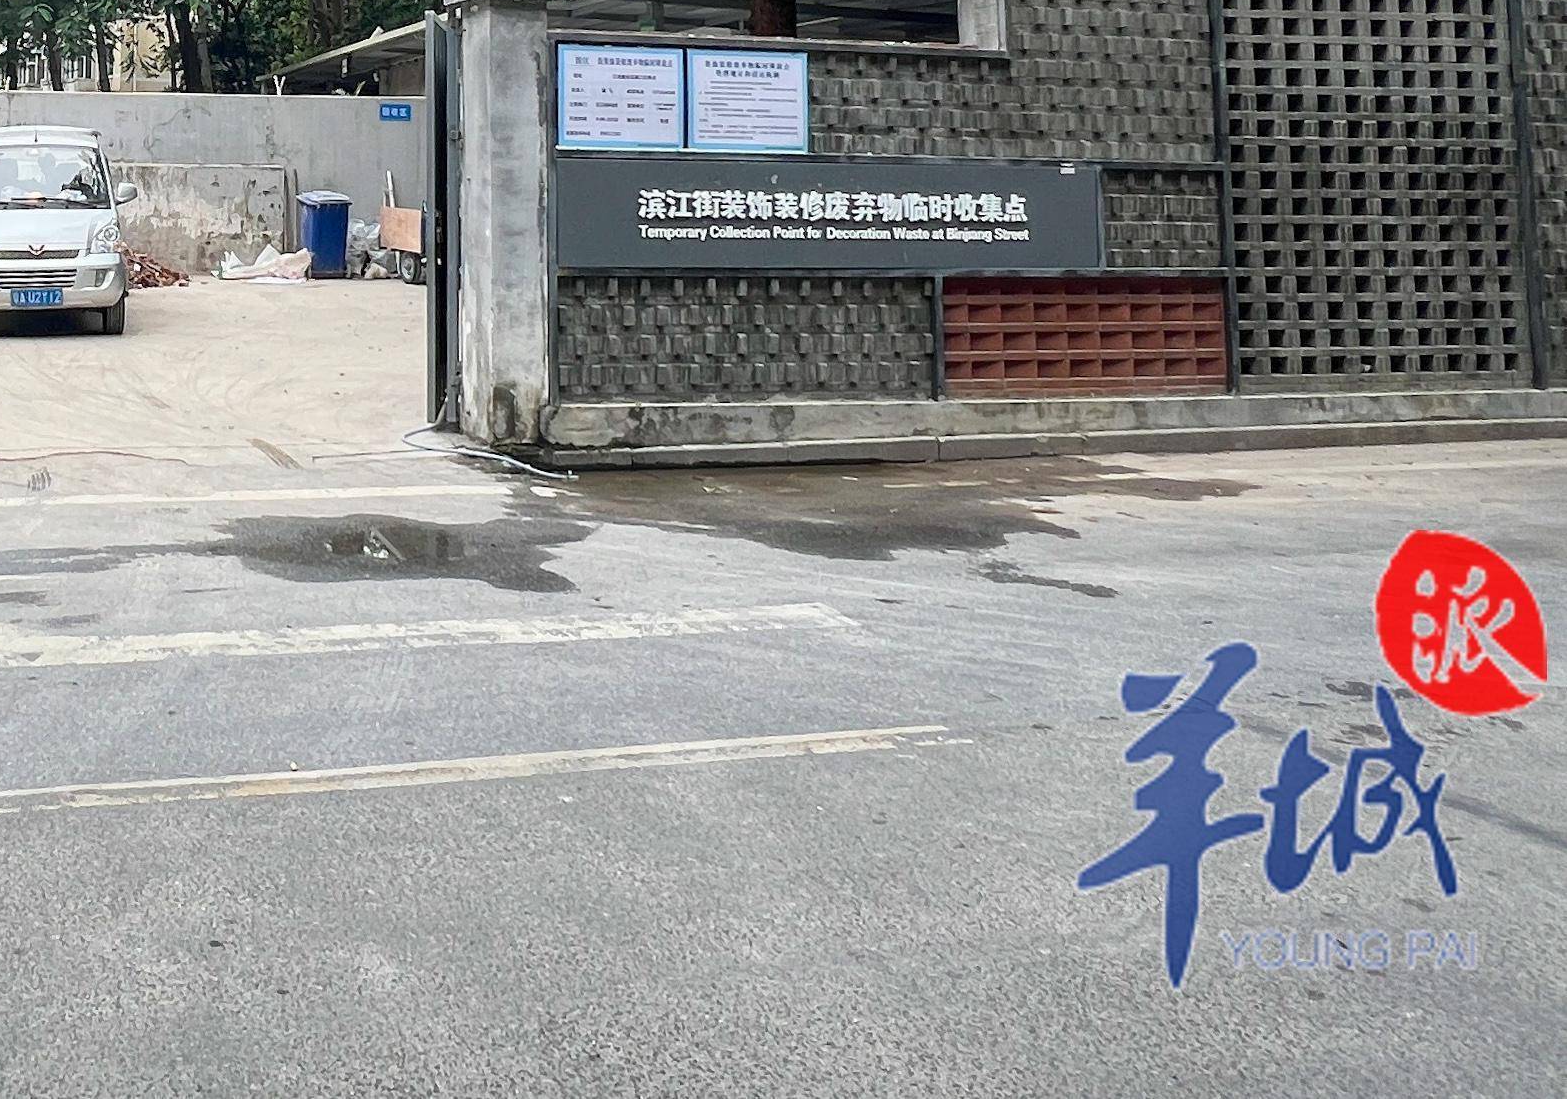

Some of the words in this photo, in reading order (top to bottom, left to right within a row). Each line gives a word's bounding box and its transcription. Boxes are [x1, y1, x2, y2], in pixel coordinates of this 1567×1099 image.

[638, 189, 1028, 222] 滨江街装饰装修废弃物临时收集点
[638, 224, 707, 241] Temporary
[709, 225, 770, 239] Collection
[772, 225, 805, 239] Point
[807, 226, 822, 239] for
[826, 226, 891, 240] Decoration
[893, 227, 929, 240] Waste
[931, 228, 944, 240] at
[994, 227, 1029, 241] Street
